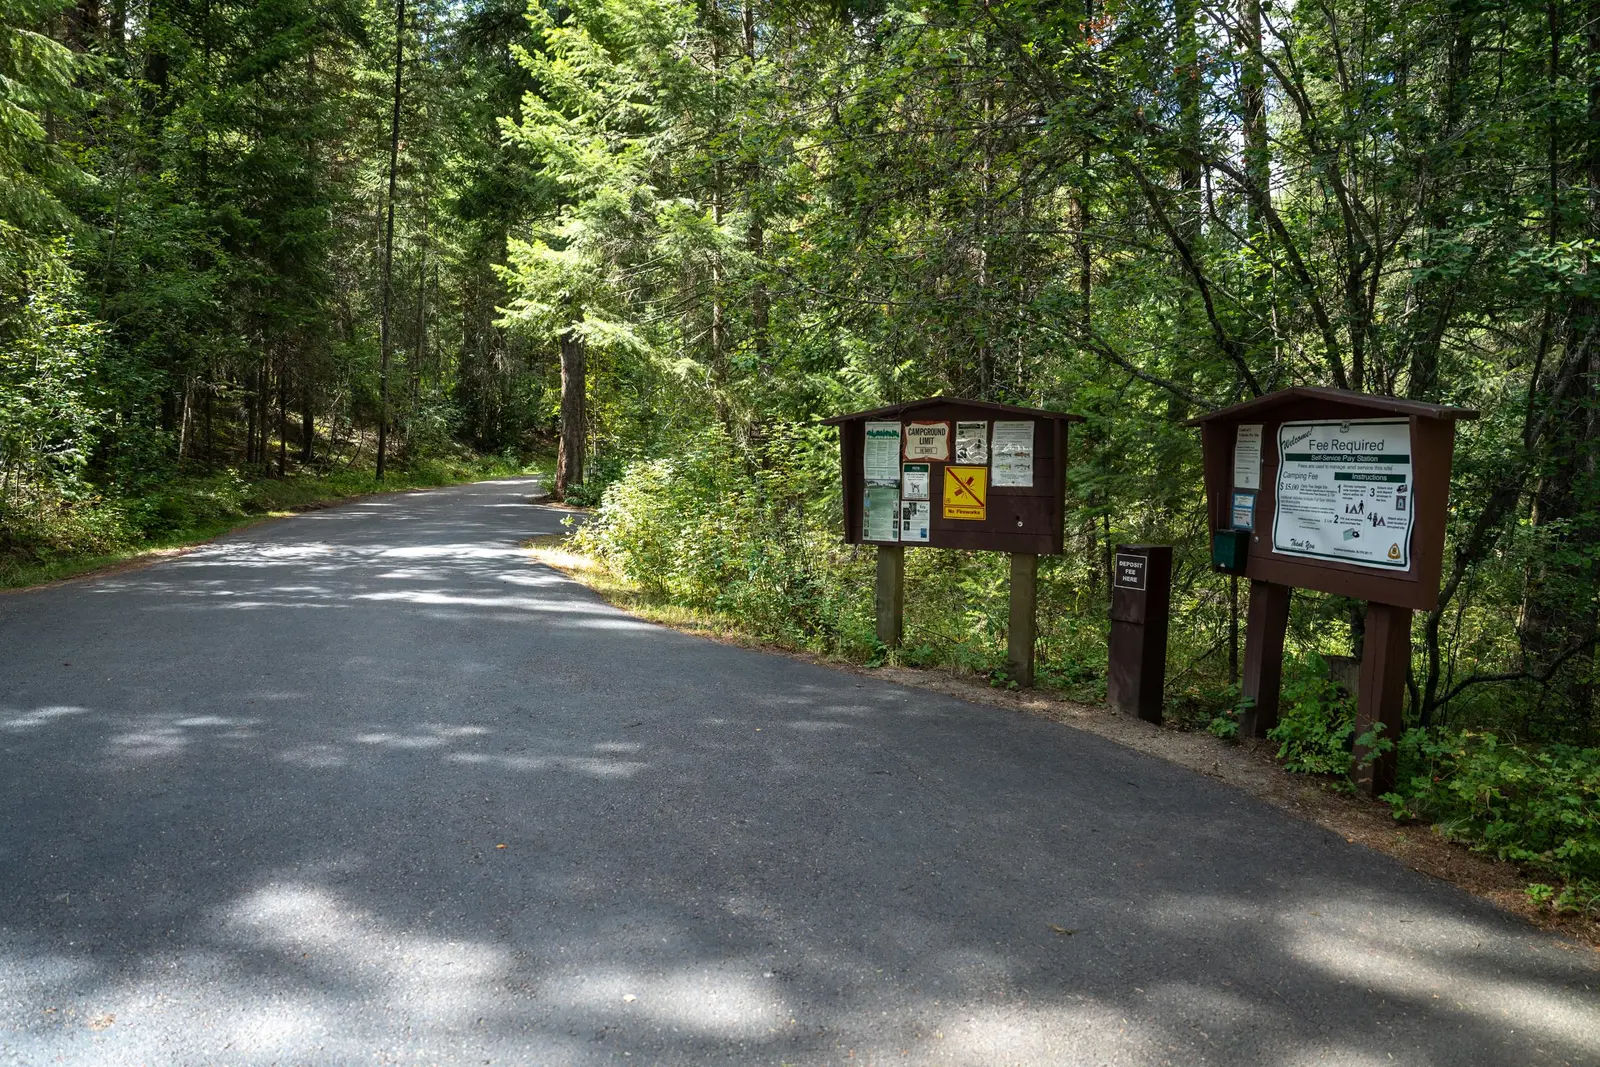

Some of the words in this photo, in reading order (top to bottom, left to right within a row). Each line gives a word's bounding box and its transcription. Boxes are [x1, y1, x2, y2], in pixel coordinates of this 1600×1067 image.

[908, 427, 946, 437] CAMPGROUND
[919, 437, 934, 446] LIMIT
[1281, 426, 1314, 450] Welcome!
[1309, 439, 1329, 451] Fee
[1331, 439, 1385, 454] Required
[1342, 454, 1355, 462] Pay
[1283, 471, 1307, 481] Camping
[1308, 472, 1319, 480] Fee
[1352, 473, 1388, 481] Instructions
[1338, 484, 1342, 494] 1
[1370, 487, 1376, 497] 3
[1333, 514, 1339, 524] 2
[1367, 512, 1372, 521] 4
[1290, 538, 1304, 549] Thank
[1305, 541, 1316, 551] You
